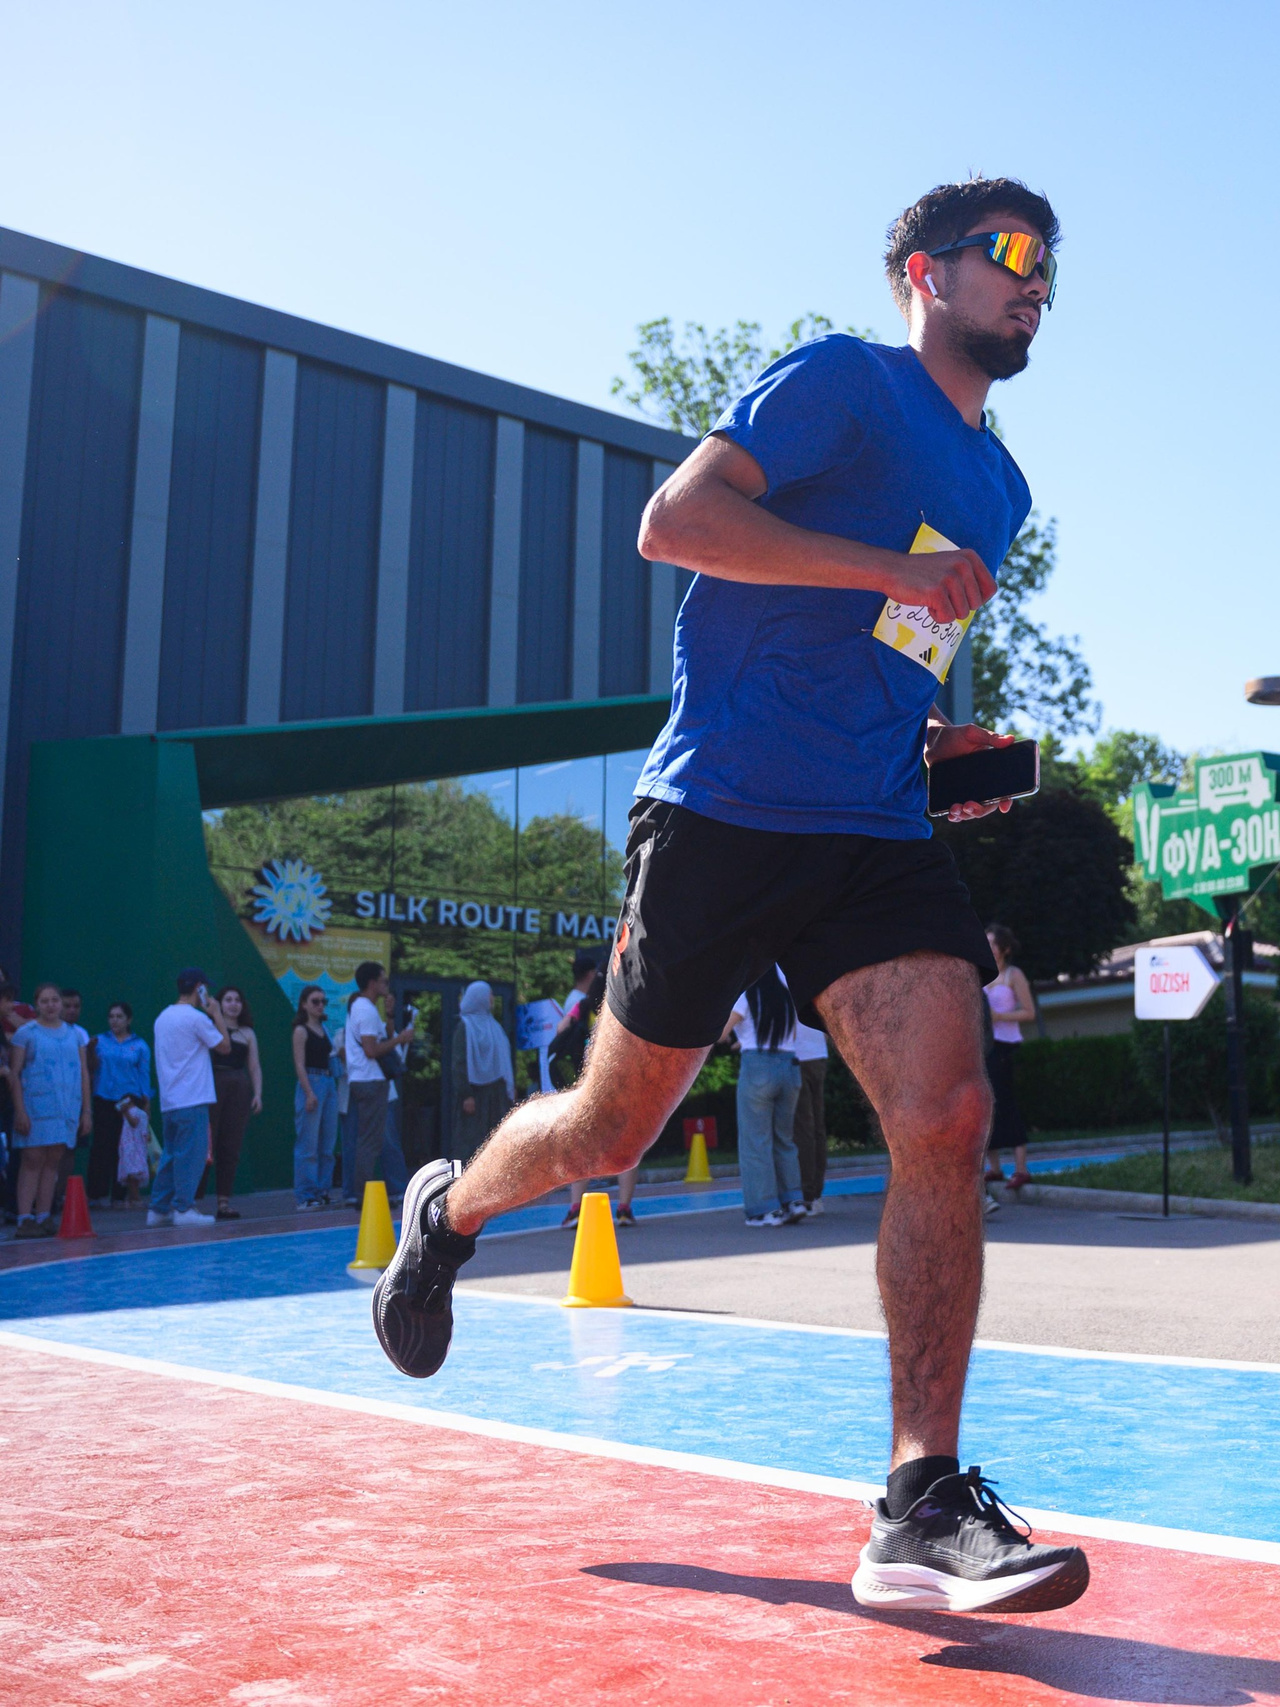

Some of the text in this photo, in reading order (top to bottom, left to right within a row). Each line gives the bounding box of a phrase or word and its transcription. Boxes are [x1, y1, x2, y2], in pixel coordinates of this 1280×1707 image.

[1209, 766, 1234, 790] 300
[356, 890, 428, 924] SILK
[438, 900, 541, 934] ROUTE
[1150, 972, 1190, 994] QIZISH
